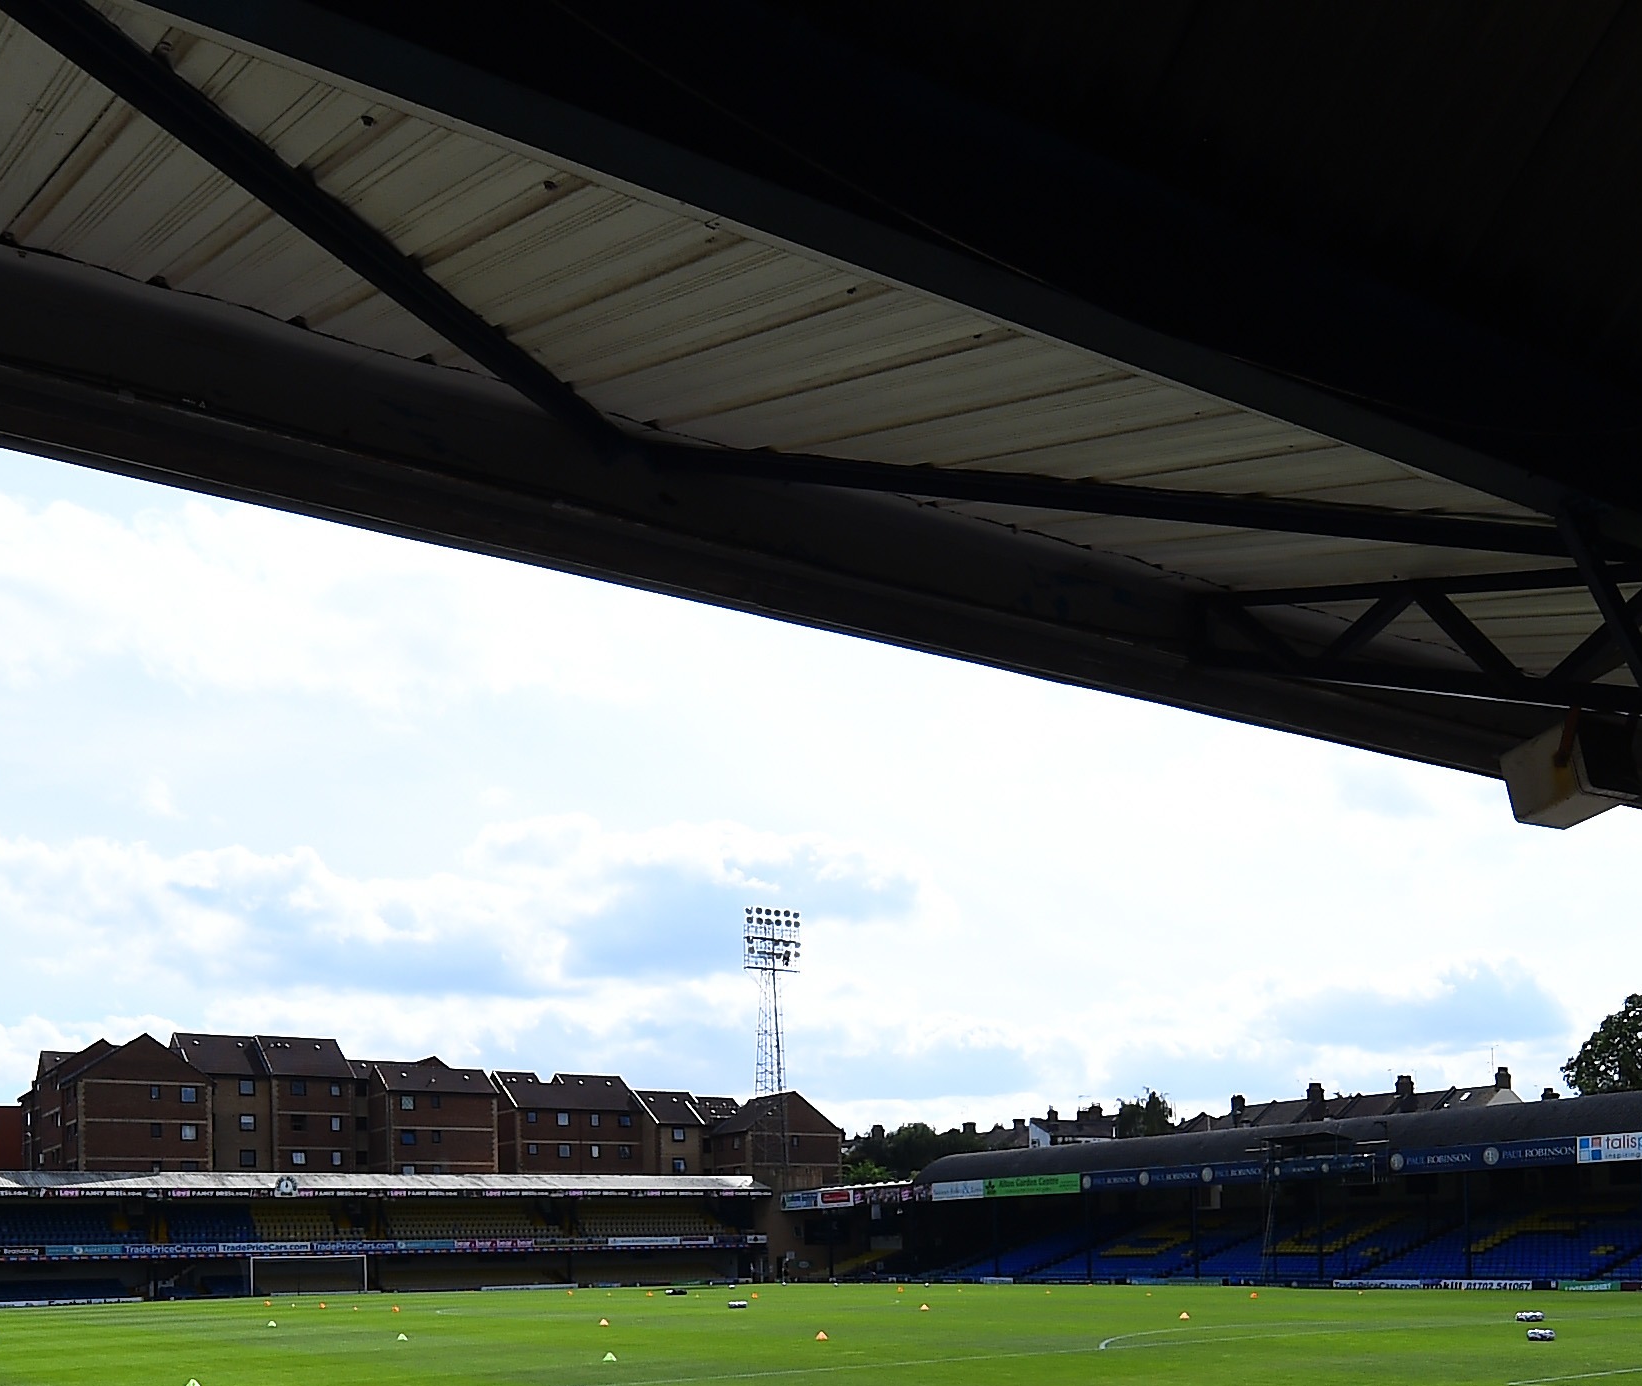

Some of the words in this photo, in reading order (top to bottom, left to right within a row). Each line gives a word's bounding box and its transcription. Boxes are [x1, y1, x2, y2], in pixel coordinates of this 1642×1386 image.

[1525, 1145, 1575, 1158] ROBINSON
[1426, 1153, 1471, 1165] ROBINSON
[1230, 1168, 1261, 1177] ROBINSO
[124, 1245, 217, 1253] TradePriceCars.com
